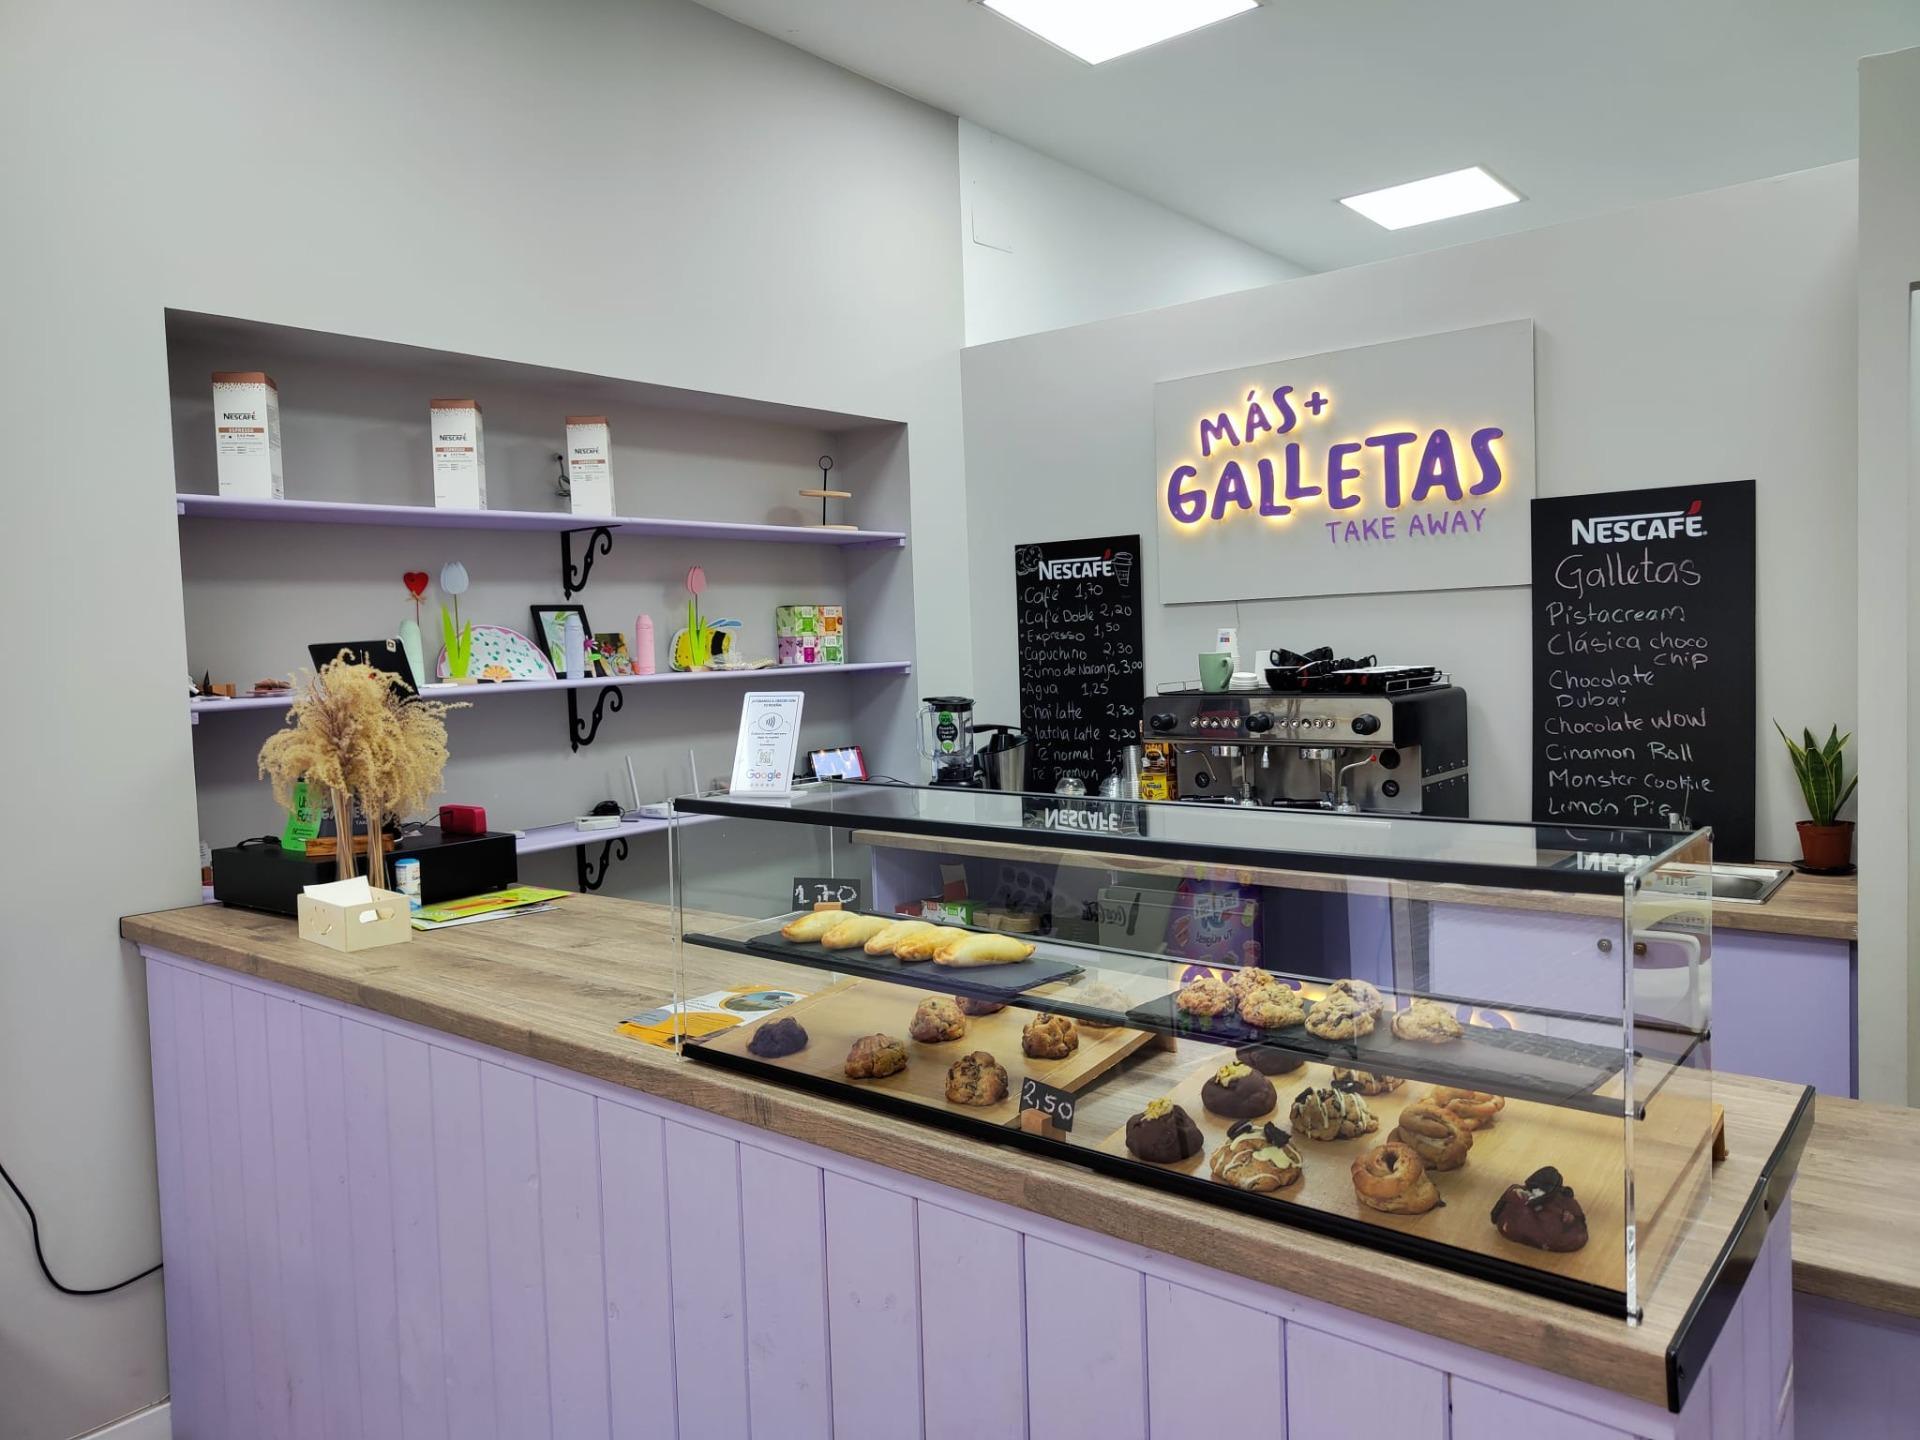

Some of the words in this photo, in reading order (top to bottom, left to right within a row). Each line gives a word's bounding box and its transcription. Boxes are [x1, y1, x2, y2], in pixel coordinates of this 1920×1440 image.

[223, 411, 257, 420] NESCAFÉ
[1167, 427, 1504, 524] GALLETAS
[1325, 516, 1396, 544] TAKE
[1408, 508, 1487, 538] AWAY
[1571, 500, 1703, 546] NESCAFÉ
[1039, 549, 1113, 581] NESCAFÉ
[1555, 547, 1701, 600] Galletas
[1024, 584, 1060, 609] Café
[1074, 582, 1104, 600] 1,70
[1025, 607, 1060, 630] Café
[1063, 604, 1095, 622] Doble
[1100, 603, 1133, 617] 2,20
[1546, 601, 1686, 627] Pistacream
[1094, 622, 1121, 639] 1,50
[1024, 646, 1088, 666] Capuchino
[1102, 642, 1134, 657] 2,30
[1547, 631, 1642, 656] Clásica
[1649, 632, 1709, 649] choco
[1023, 663, 1061, 679] Zumo
[1063, 663, 1077, 676] de
[1078, 663, 1120, 682] Naranja
[1121, 659, 1143, 674] 3,00
[1549, 664, 1656, 690] Chocolate
[1025, 683, 1059, 701] Agua
[1081, 682, 1110, 697] 1,25
[1022, 703, 1052, 720] Chai
[1106, 703, 1135, 719] 2,30
[1108, 728, 1137, 741] 2,30
[1544, 712, 1646, 735] Chocolate
[1053, 746, 1095, 761] normal
[1104, 747, 1122, 765] 1,7
[1545, 743, 1636, 762] Cinamon
[1646, 742, 1694, 763] Roll
[746, 769, 782, 781] Google
[1549, 769, 1637, 789] Monster
[1548, 797, 1620, 816] Limón
[1624, 795, 1673, 817] Pie
[794, 884, 858, 904] 1,70
[1023, 1080, 1073, 1120] 2,50
